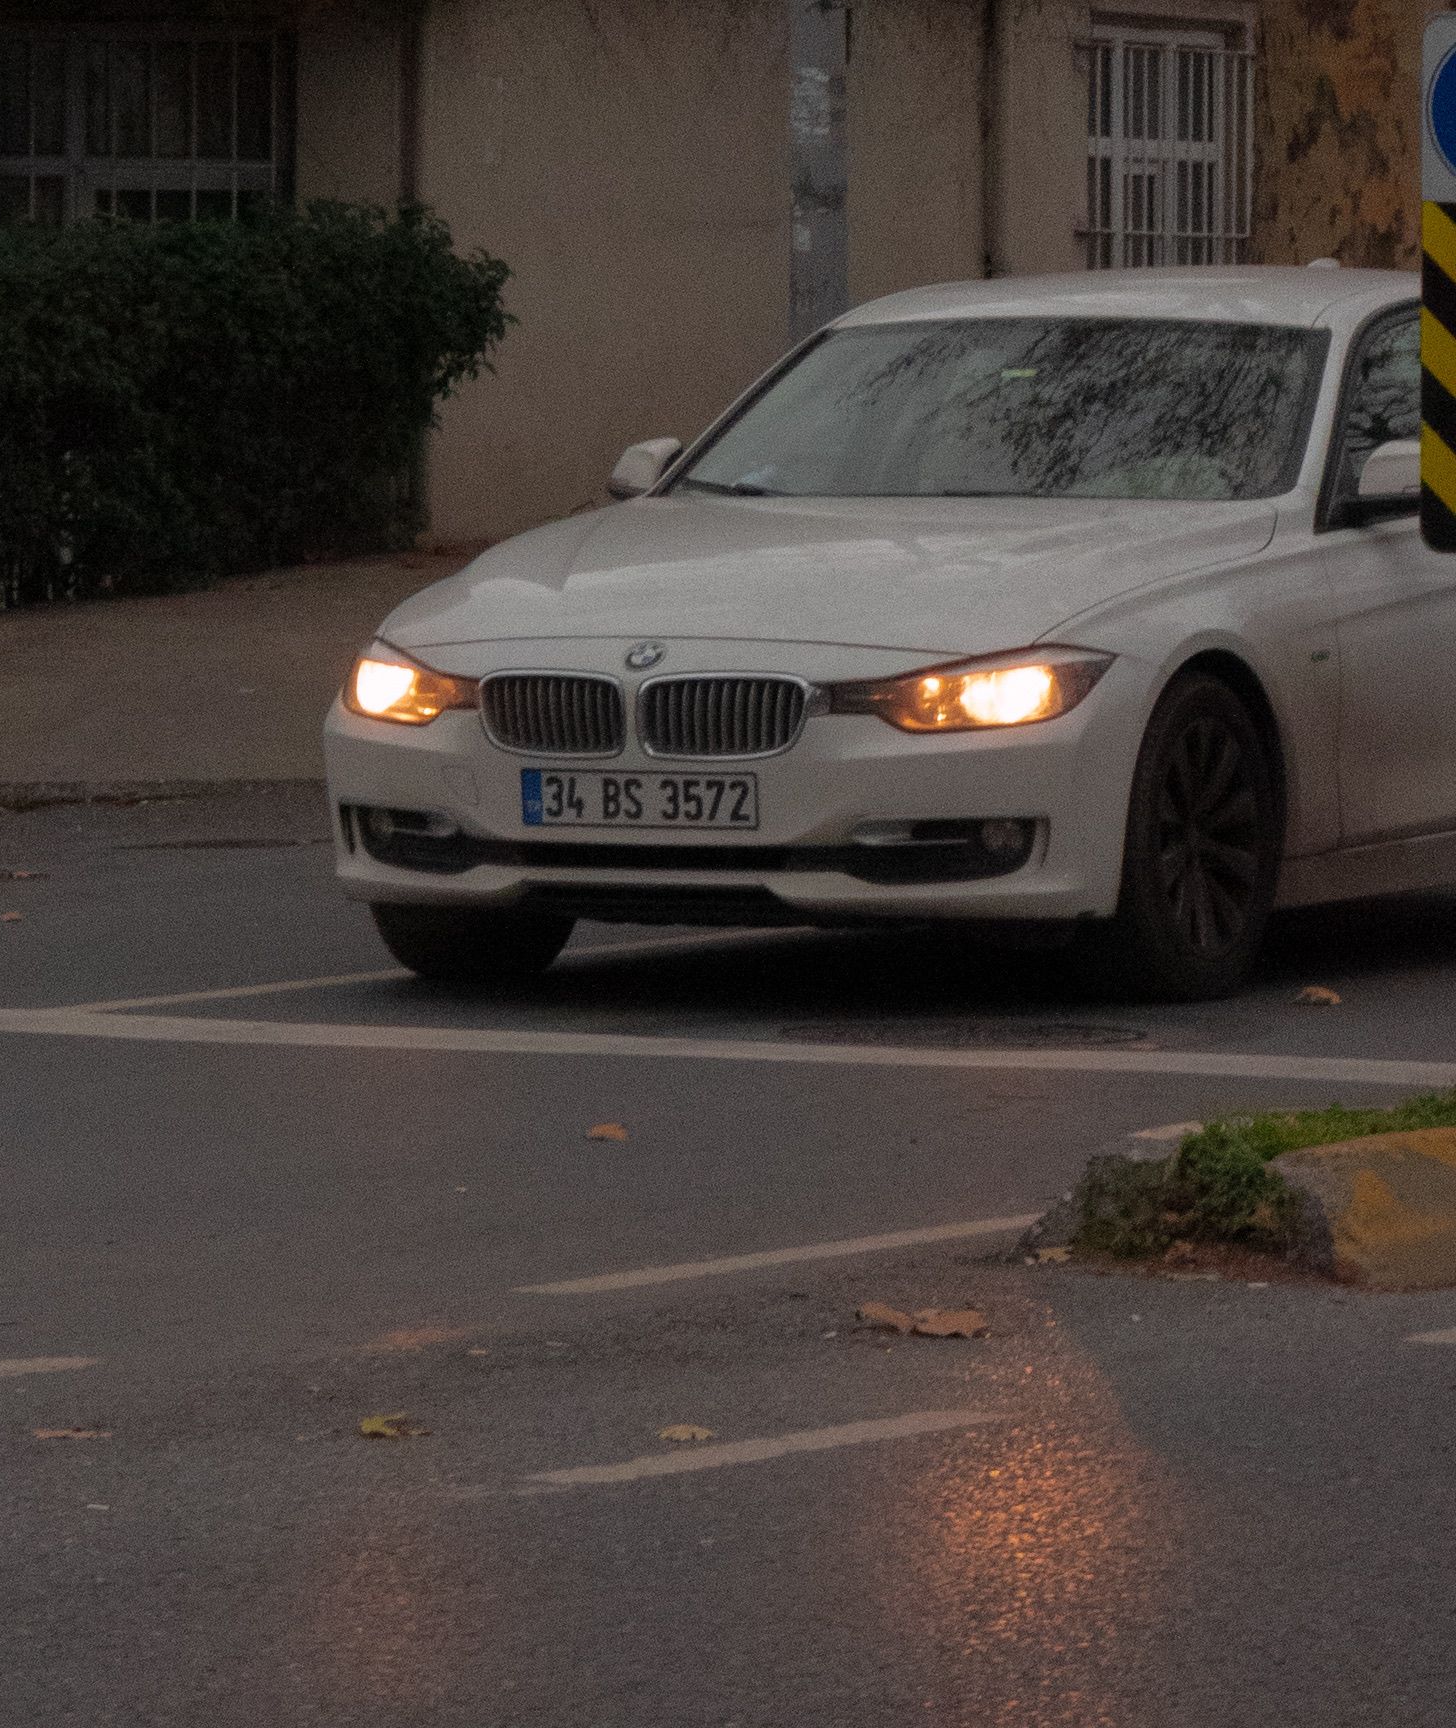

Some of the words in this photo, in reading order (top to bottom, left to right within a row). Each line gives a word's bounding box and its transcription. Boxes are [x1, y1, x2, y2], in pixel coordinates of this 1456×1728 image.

[545, 775, 585, 819] 34
[602, 777, 643, 820] BS
[659, 778, 751, 823] 3572
